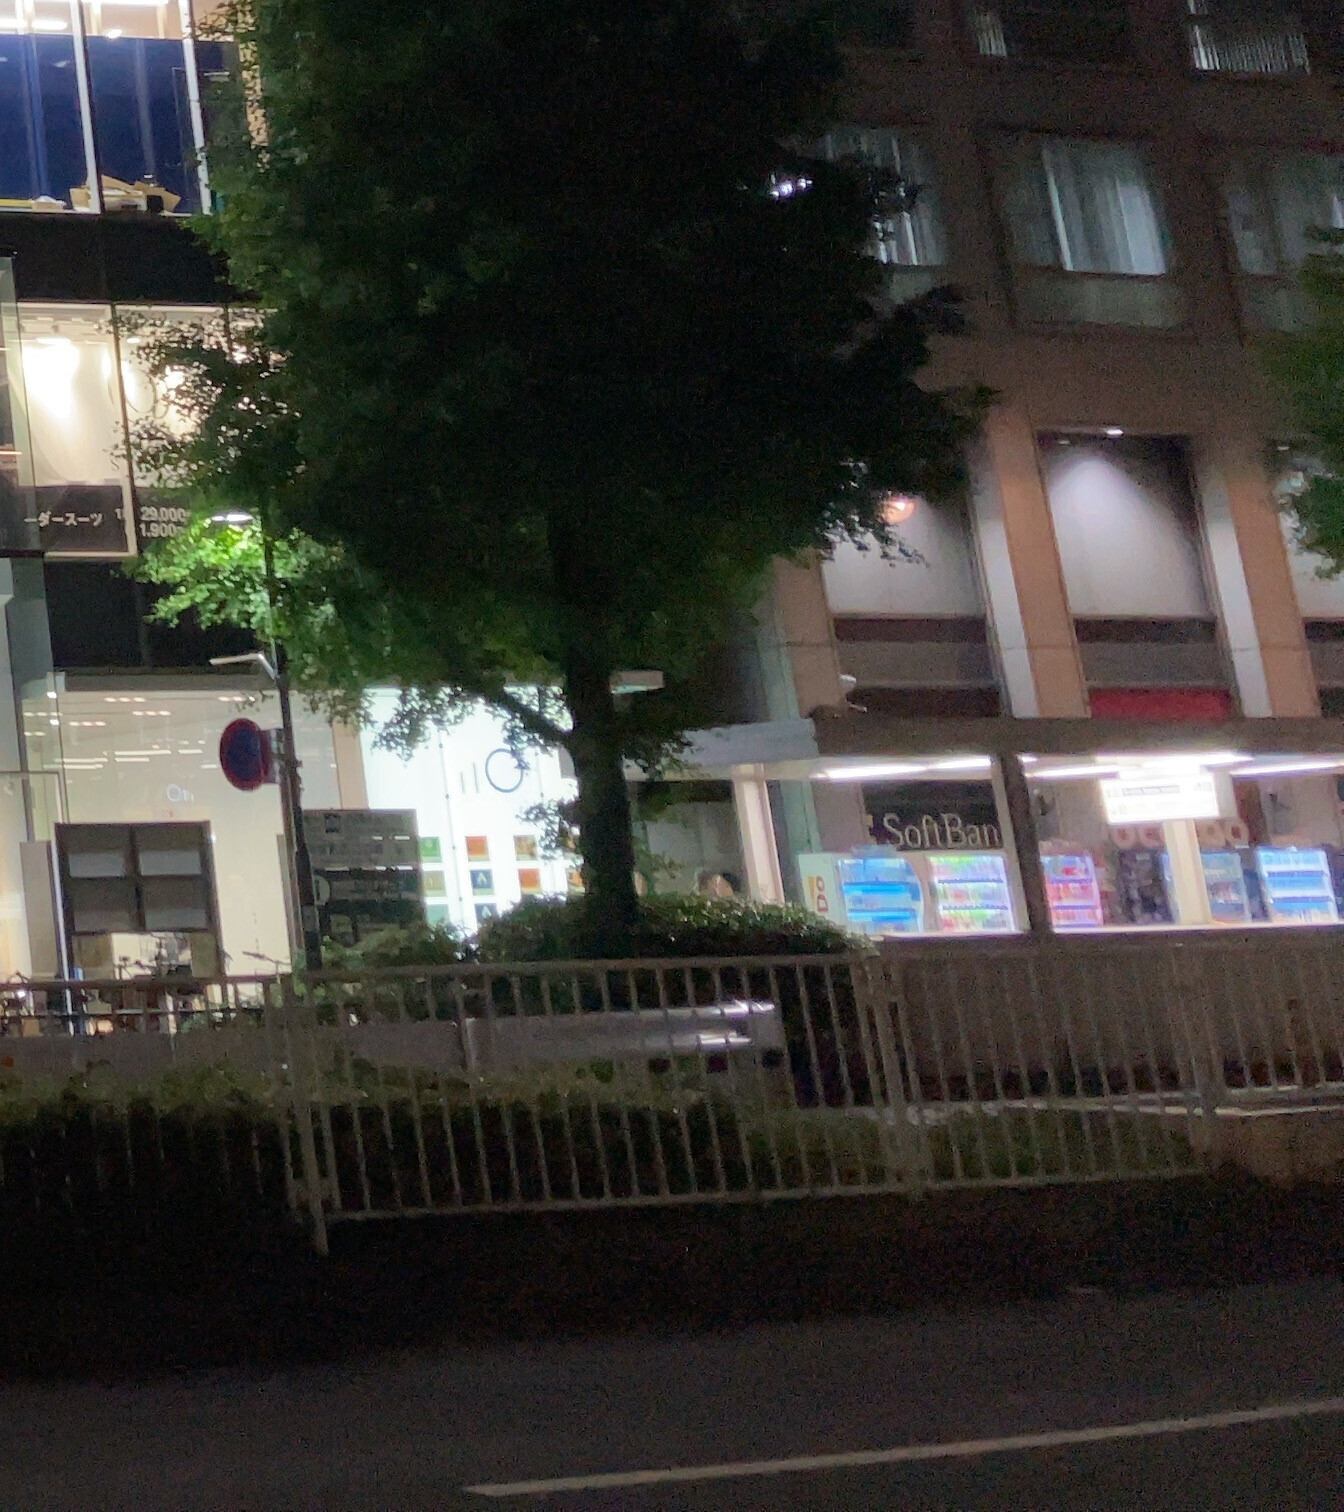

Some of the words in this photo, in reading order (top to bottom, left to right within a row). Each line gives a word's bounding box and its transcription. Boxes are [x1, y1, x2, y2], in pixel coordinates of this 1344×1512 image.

[24, 509, 103, 527] ーダースーツ
[883, 813, 1002, 849] SoftBan
